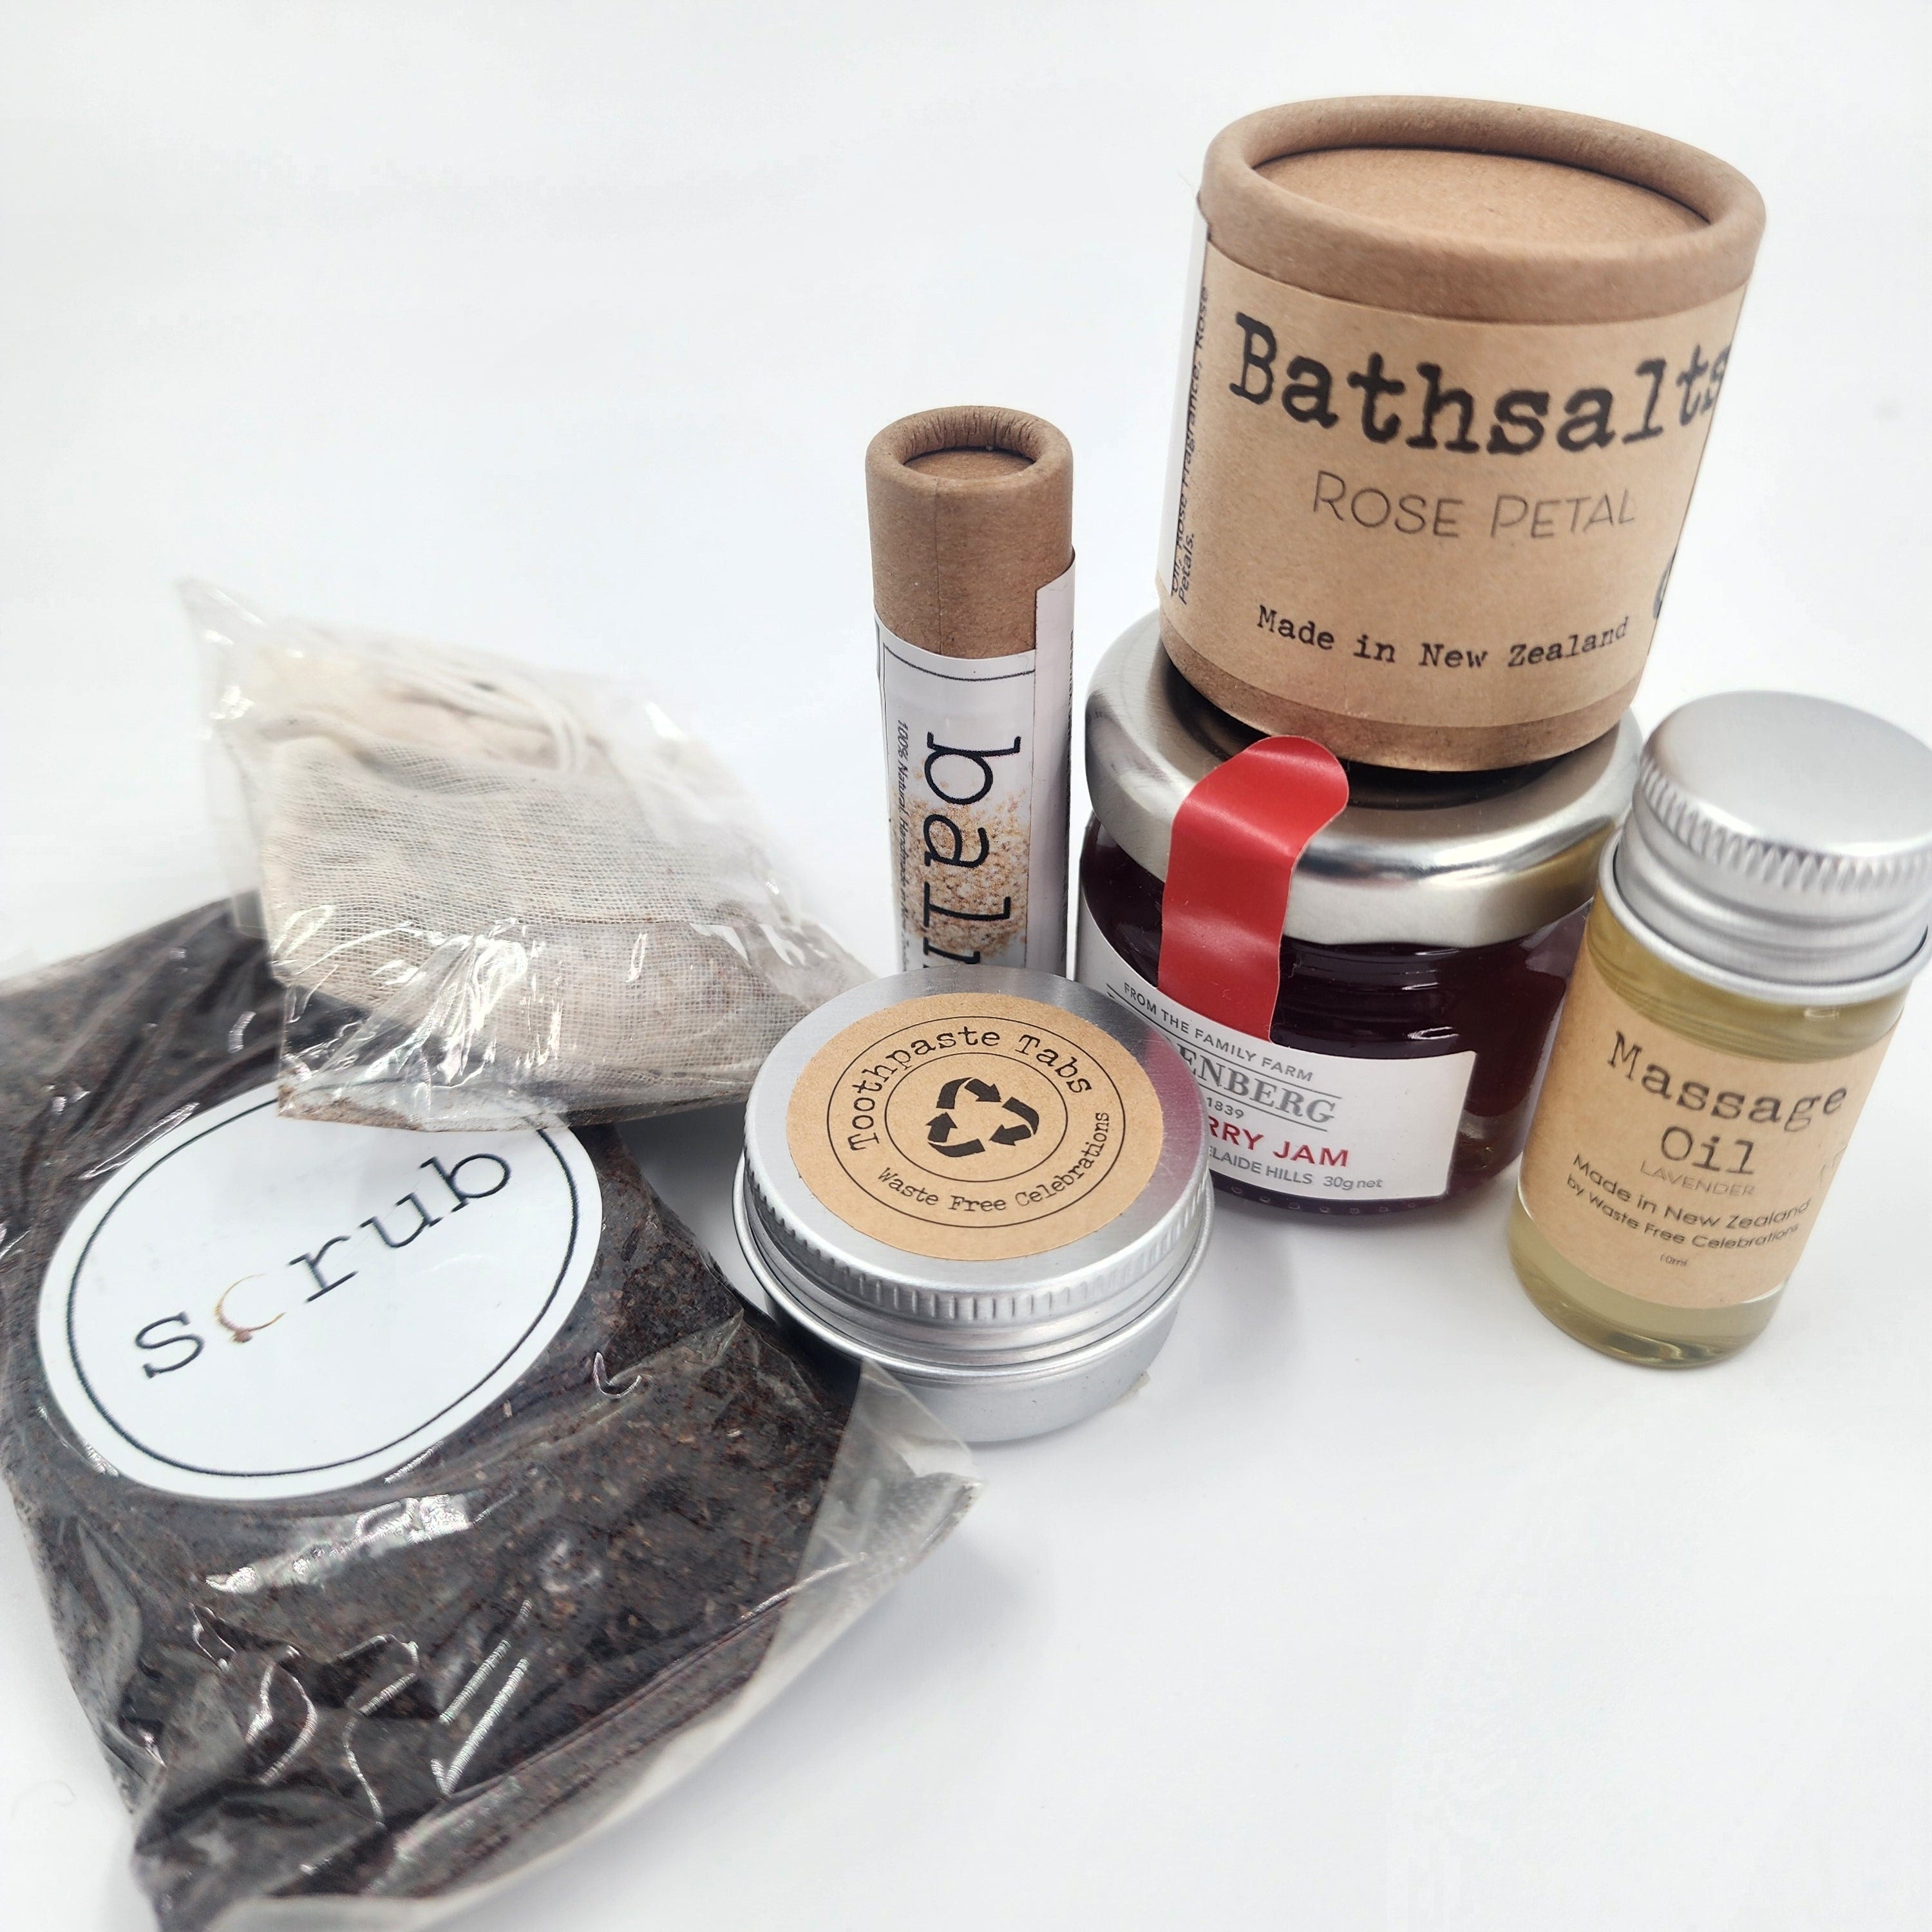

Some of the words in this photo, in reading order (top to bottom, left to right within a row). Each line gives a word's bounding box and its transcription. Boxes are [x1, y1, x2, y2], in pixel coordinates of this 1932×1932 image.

[1229, 312, 1732, 455] Bathsalts
[1312, 470, 1464, 538] ROSE
[1490, 488, 1636, 538] PETAL
[1179, 533, 1195, 605] Petals.
[1256, 604, 1335, 650] Made
[1354, 636, 1396, 664] in
[1418, 643, 1488, 668] New
[1508, 616, 1629, 667] Zealand
[1124, 981, 1157, 1015] FROM
[1161, 1008, 1189, 1034] THE
[1195, 1028, 1257, 1063] FAMILY
[1262, 1056, 1313, 1083] FARM
[847, 1026, 1001, 1151] Toothpaste
[1019, 1033, 1092, 1095] Tabs
[1163, 1034, 1336, 1124] ENBERG
[1206, 1097, 1244, 1119] 1839
[1607, 1030, 1847, 1132] Massage
[878, 1167, 940, 1206] Waste
[948, 1195, 1007, 1212] Free
[1015, 1112, 1110, 1207] Celebrations
[1265, 1165, 1313, 1185] HILLS
[1323, 1176, 1355, 1191] 30g
[1356, 1177, 1383, 1189] net
[1273, 1141, 1349, 1167] JAM
[1640, 1160, 1757, 1198] LAVENDER
[1660, 1125, 1756, 1176] Oil
[1566, 1173, 1585, 1197] by
[1589, 1191, 1639, 1229] Waste
[1644, 1223, 1687, 1244] Free
[1691, 1224, 1800, 1249] Celebrations
[1573, 1153, 1631, 1202] Made
[1636, 1194, 1658, 1213] in
[1664, 1206, 1721, 1228] New
[1725, 1197, 1812, 1229] Zealand
[134, 1153, 512, 1380] scrub
